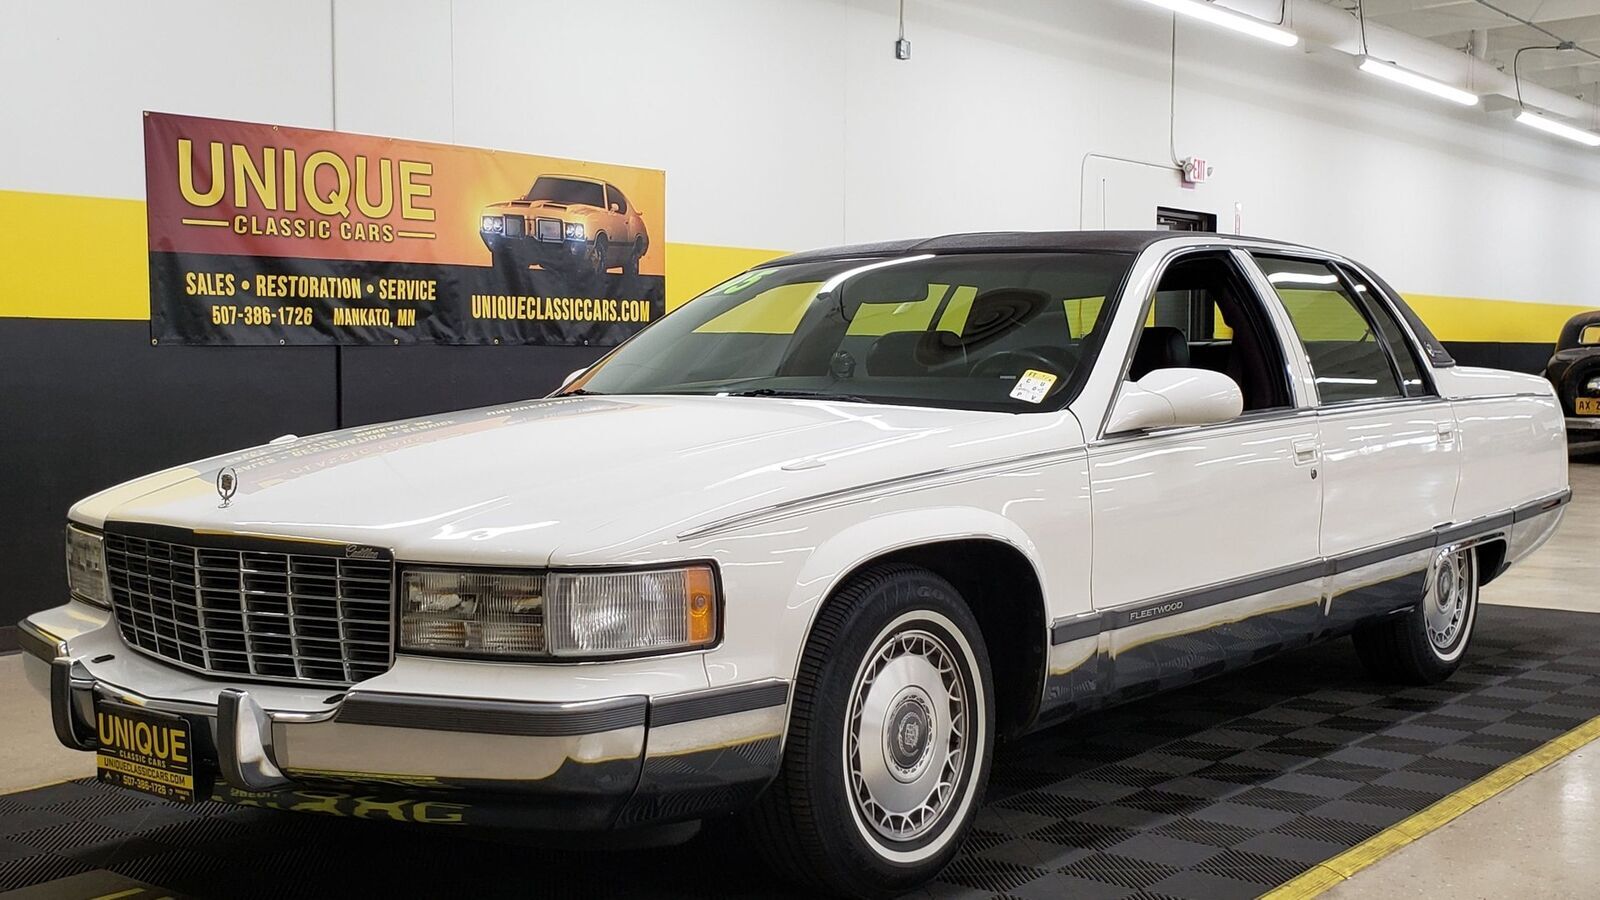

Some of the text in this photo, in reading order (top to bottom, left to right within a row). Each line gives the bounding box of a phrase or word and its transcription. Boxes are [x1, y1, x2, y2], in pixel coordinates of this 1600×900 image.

[178, 139, 436, 221] UNIQUE
[1193, 158, 1205, 181] EXIT
[233, 215, 394, 242] CLASSIC CARS
[186, 272, 436, 300] SALES RESTORATION SERVICE
[212, 305, 416, 328] 507-386-1726 MANKATO, MN
[471, 295, 650, 322] UNIQUECLASSICCARS.COM
[1579, 400, 1590, 410] AX
[1130, 601, 1183, 620] FLEETWOOD
[98, 712, 187, 763] UNIQUE
[103, 757, 186, 785] UNIQUECLASSICCARS.COM
[119, 750, 166, 768] CLASSIC CARS
